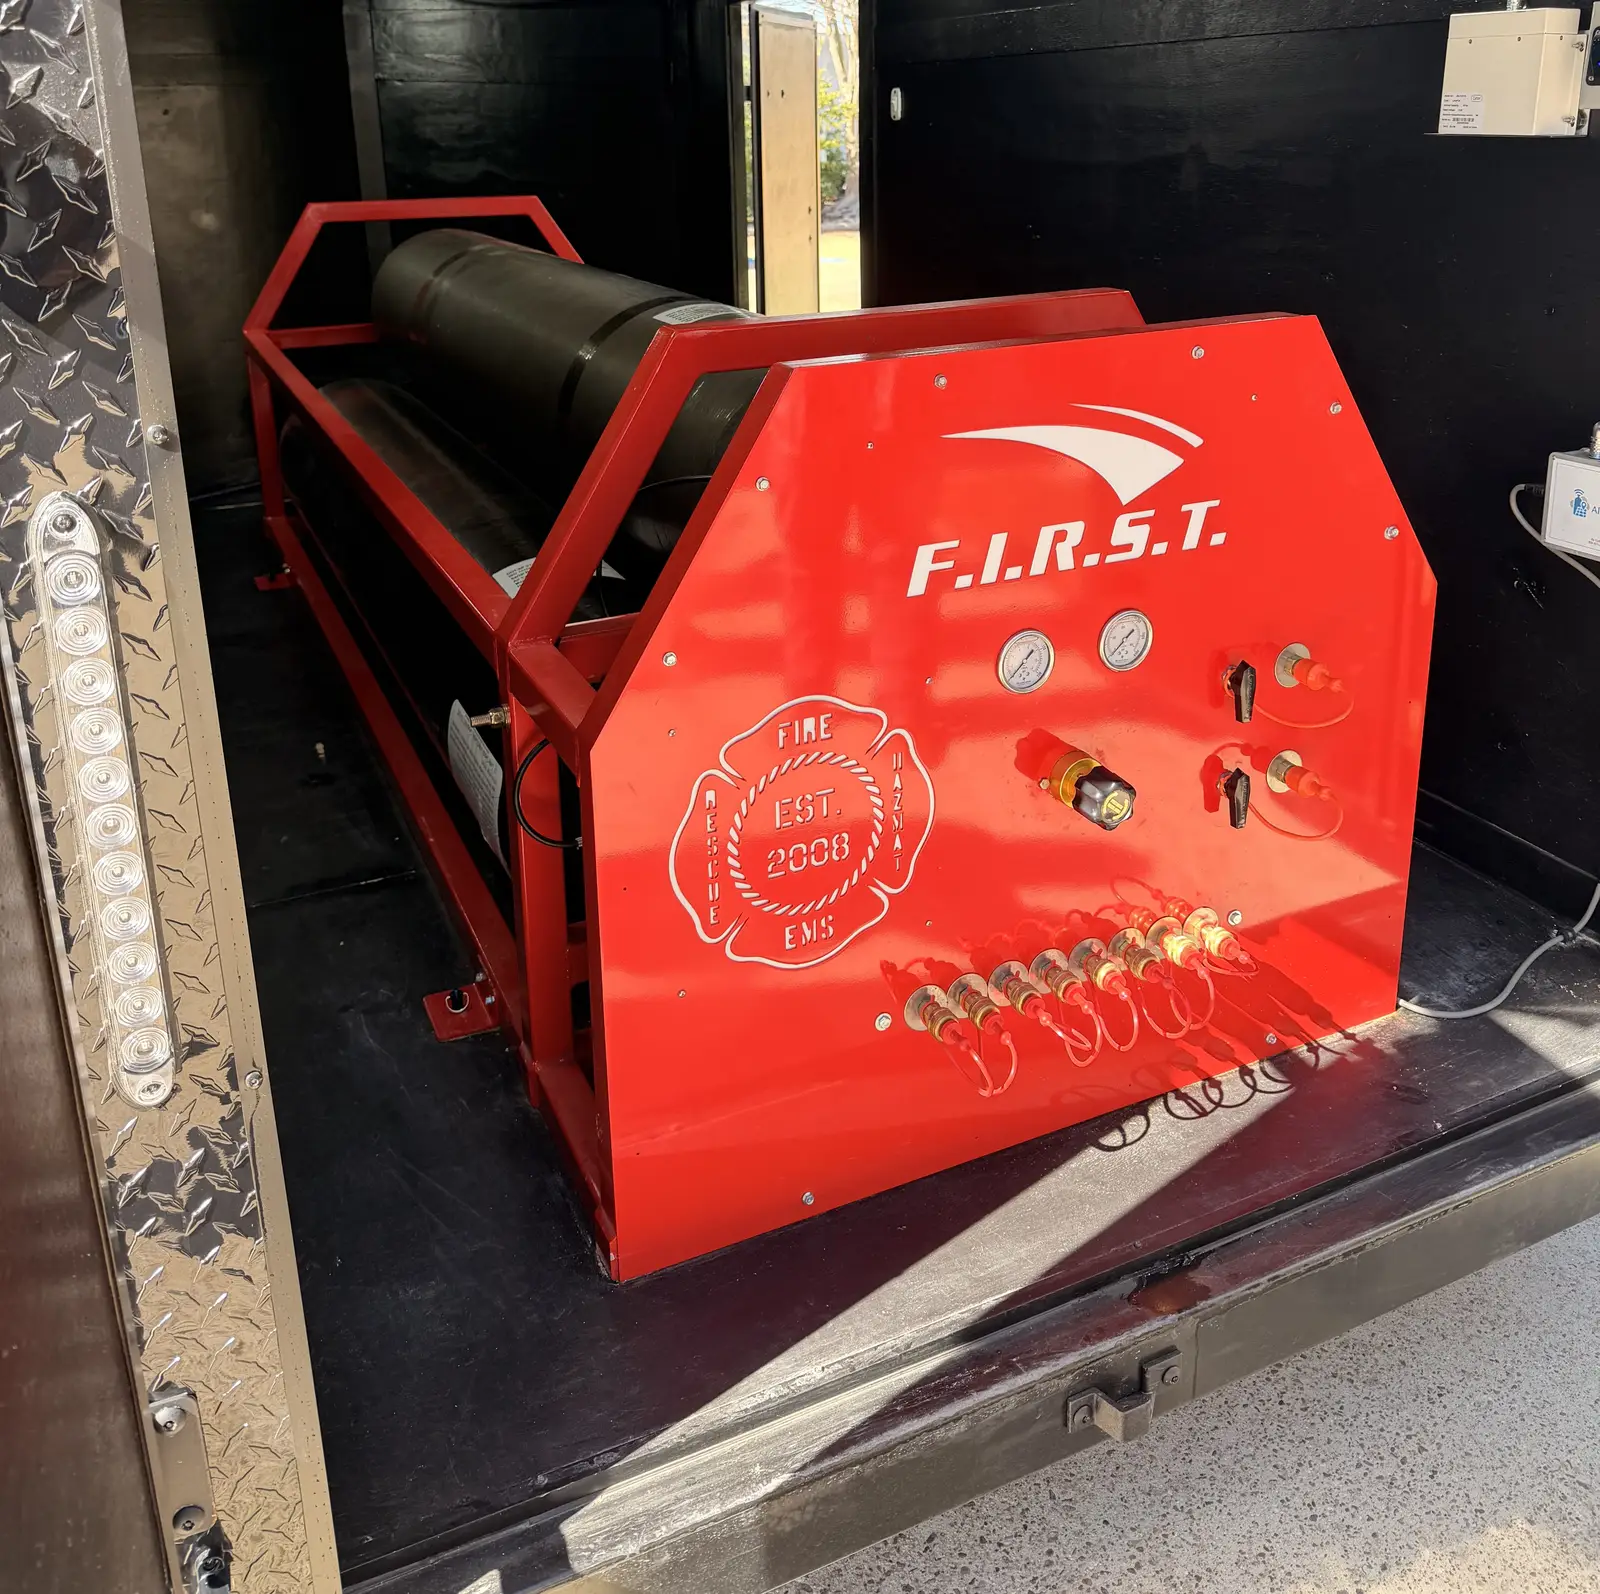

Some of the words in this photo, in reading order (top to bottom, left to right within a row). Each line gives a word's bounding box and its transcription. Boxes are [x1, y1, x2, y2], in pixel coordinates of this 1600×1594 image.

[906, 499, 1228, 597] F.I.R.S.T.
[777, 711, 833, 749] FIRE
[774, 788, 842, 829] EST.
[891, 751, 904, 872] HAZMAT
[704, 788, 720, 926] RESCUE
[767, 832, 849, 878] 2008
[784, 915, 835, 950] EMS
